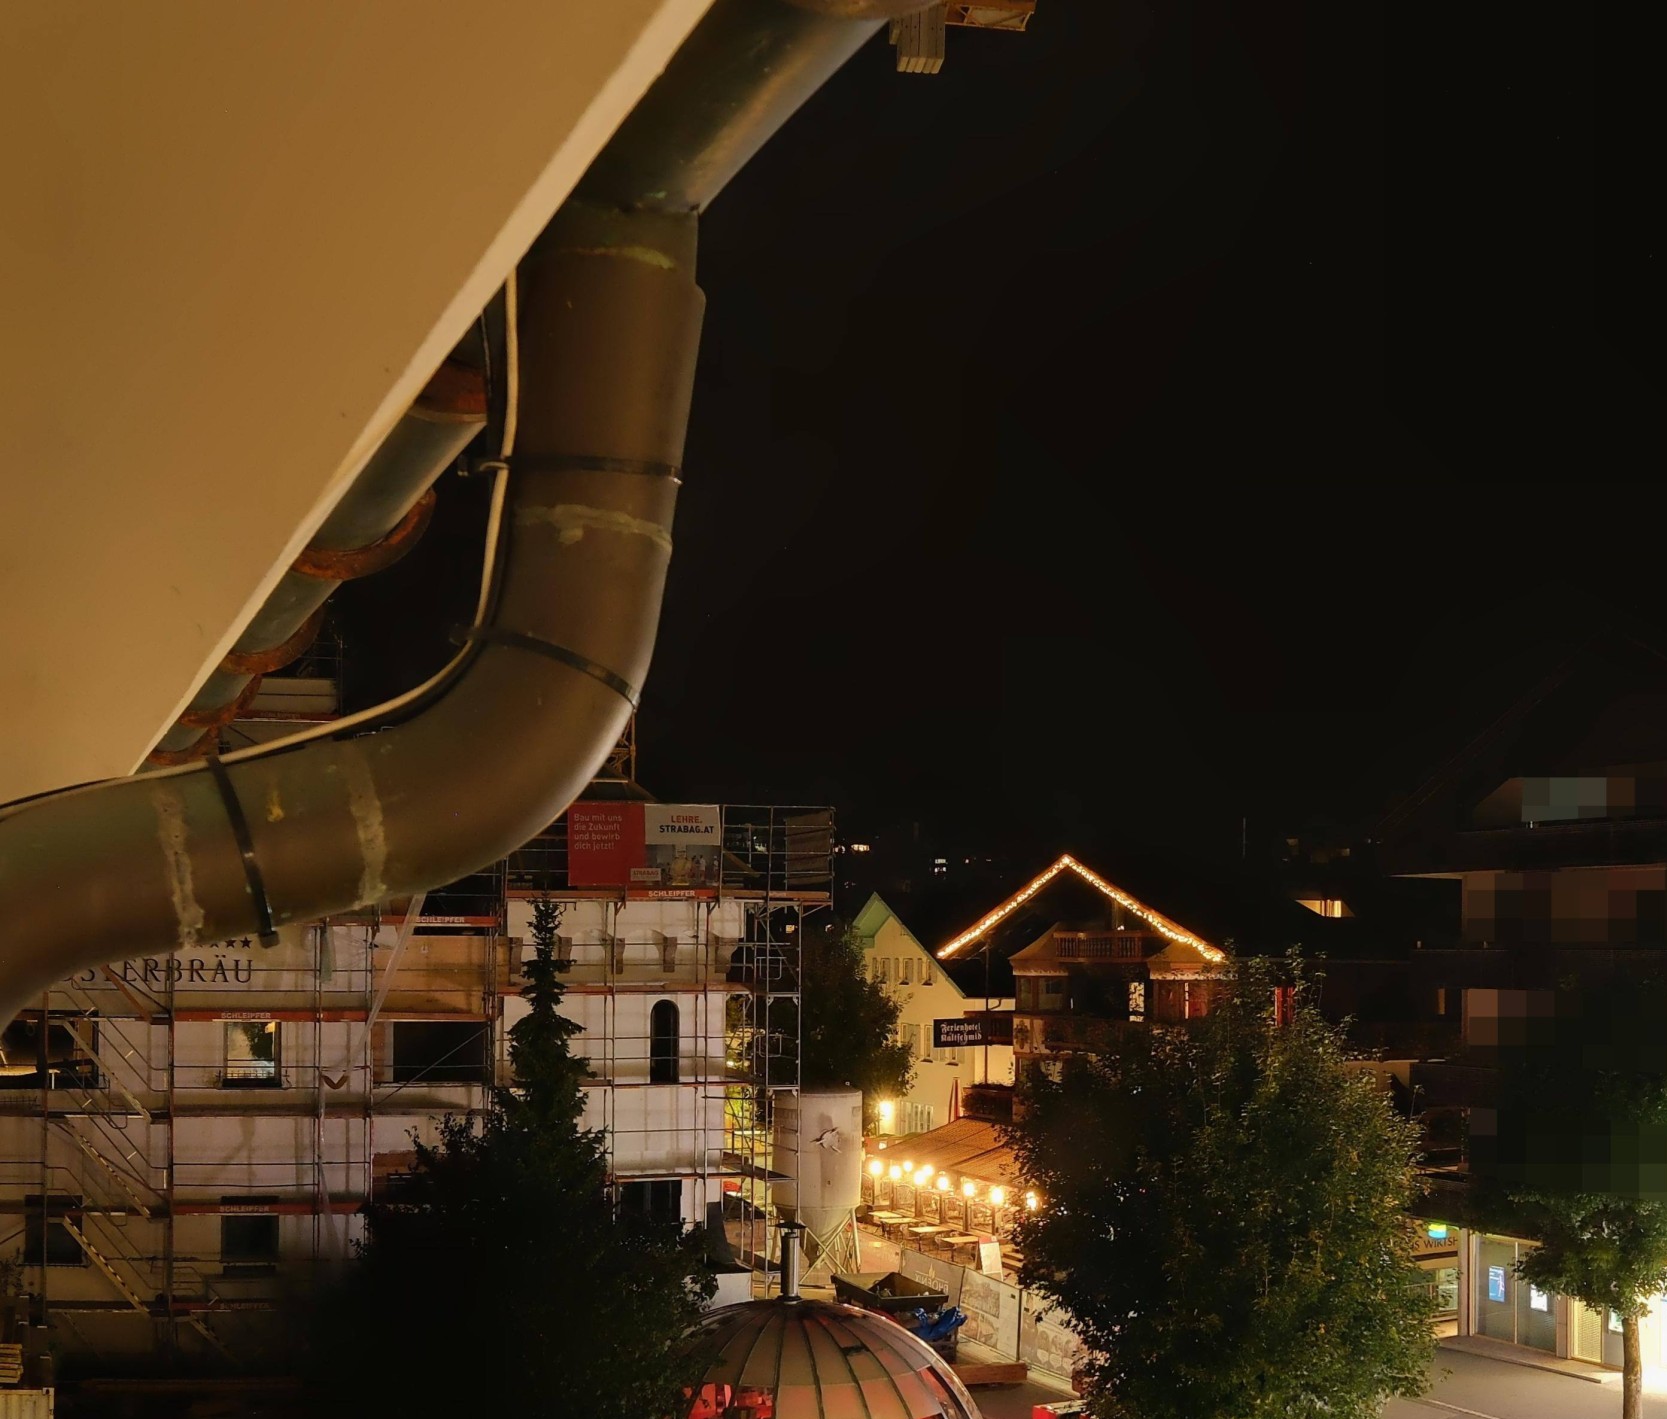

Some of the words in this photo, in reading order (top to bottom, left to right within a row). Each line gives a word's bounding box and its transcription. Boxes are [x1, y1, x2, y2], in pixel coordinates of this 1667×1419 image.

[592, 813, 606, 821] mit
[670, 815, 702, 824] LEHRE.
[589, 822, 621, 831] Zukunft
[659, 825, 714, 834] STRABAG.AT
[574, 832, 587, 840] und
[574, 842, 590, 850] dich
[648, 889, 696, 898] SCHLEIPFER
[416, 916, 465, 924] SCHLEIPFER
[221, 1012, 271, 1020] SCHLEIPFER
